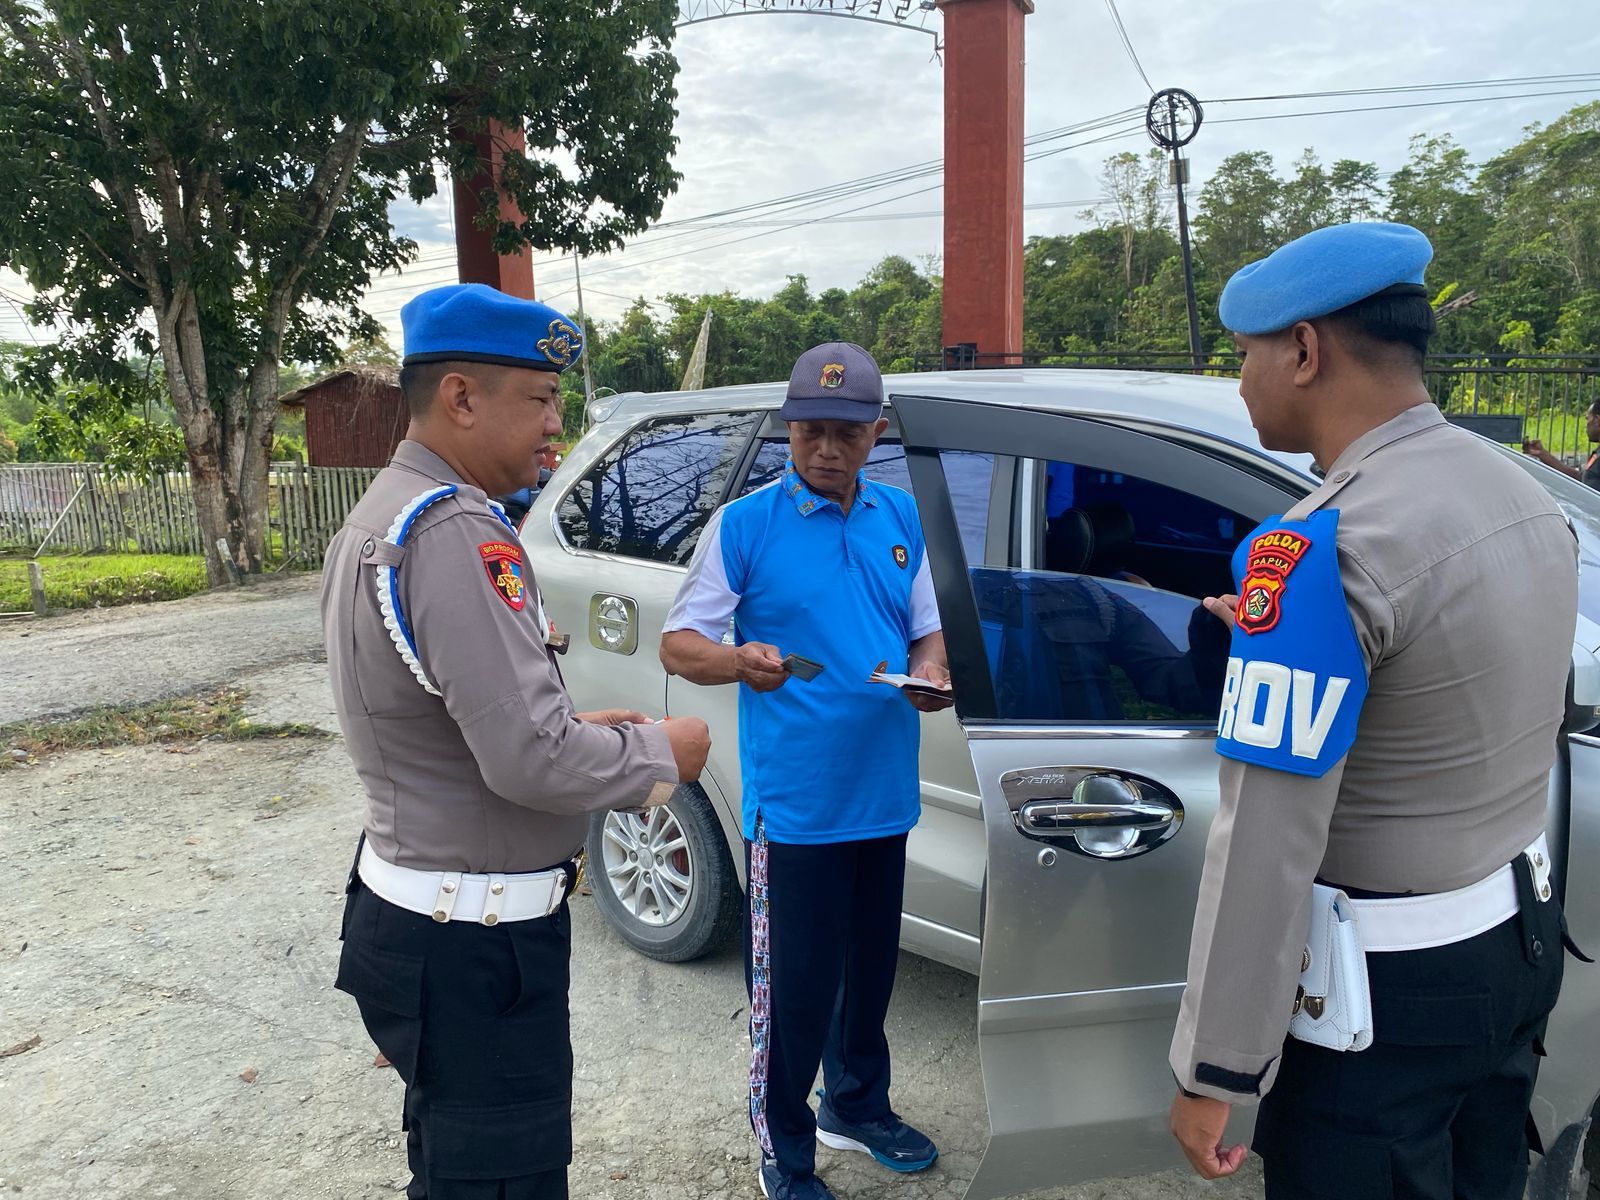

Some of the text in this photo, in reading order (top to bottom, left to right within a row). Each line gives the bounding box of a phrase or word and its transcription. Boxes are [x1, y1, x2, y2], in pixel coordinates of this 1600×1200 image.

[494, 544, 518, 556] PROPAM
[1255, 533, 1302, 555] POLDA
[1253, 557, 1289, 571] PAPUA
